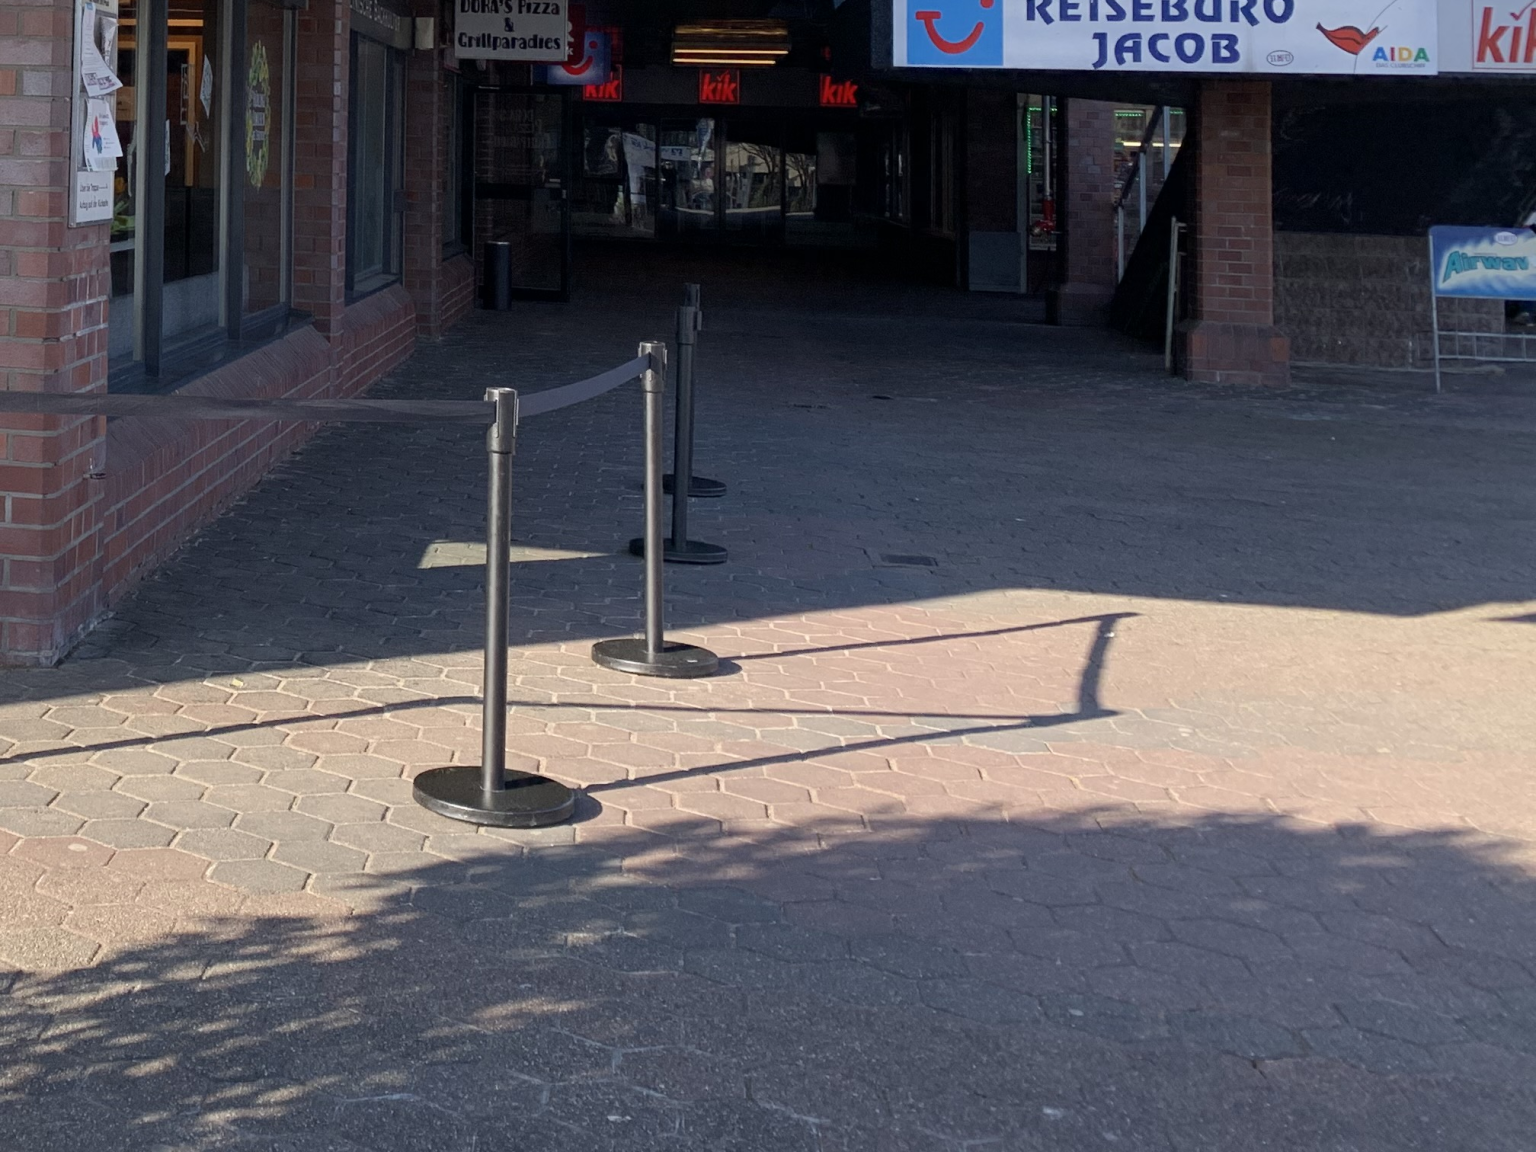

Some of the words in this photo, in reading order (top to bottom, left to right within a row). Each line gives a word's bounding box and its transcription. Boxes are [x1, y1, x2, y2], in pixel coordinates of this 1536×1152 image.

[504, 17, 514, 32] &
[458, 32, 561, 51] Grillparadies
[1091, 32, 1241, 69] JACOB
[1372, 47, 1430, 62] AIDA
[702, 72, 736, 101] kik
[822, 75, 858, 104] kik
